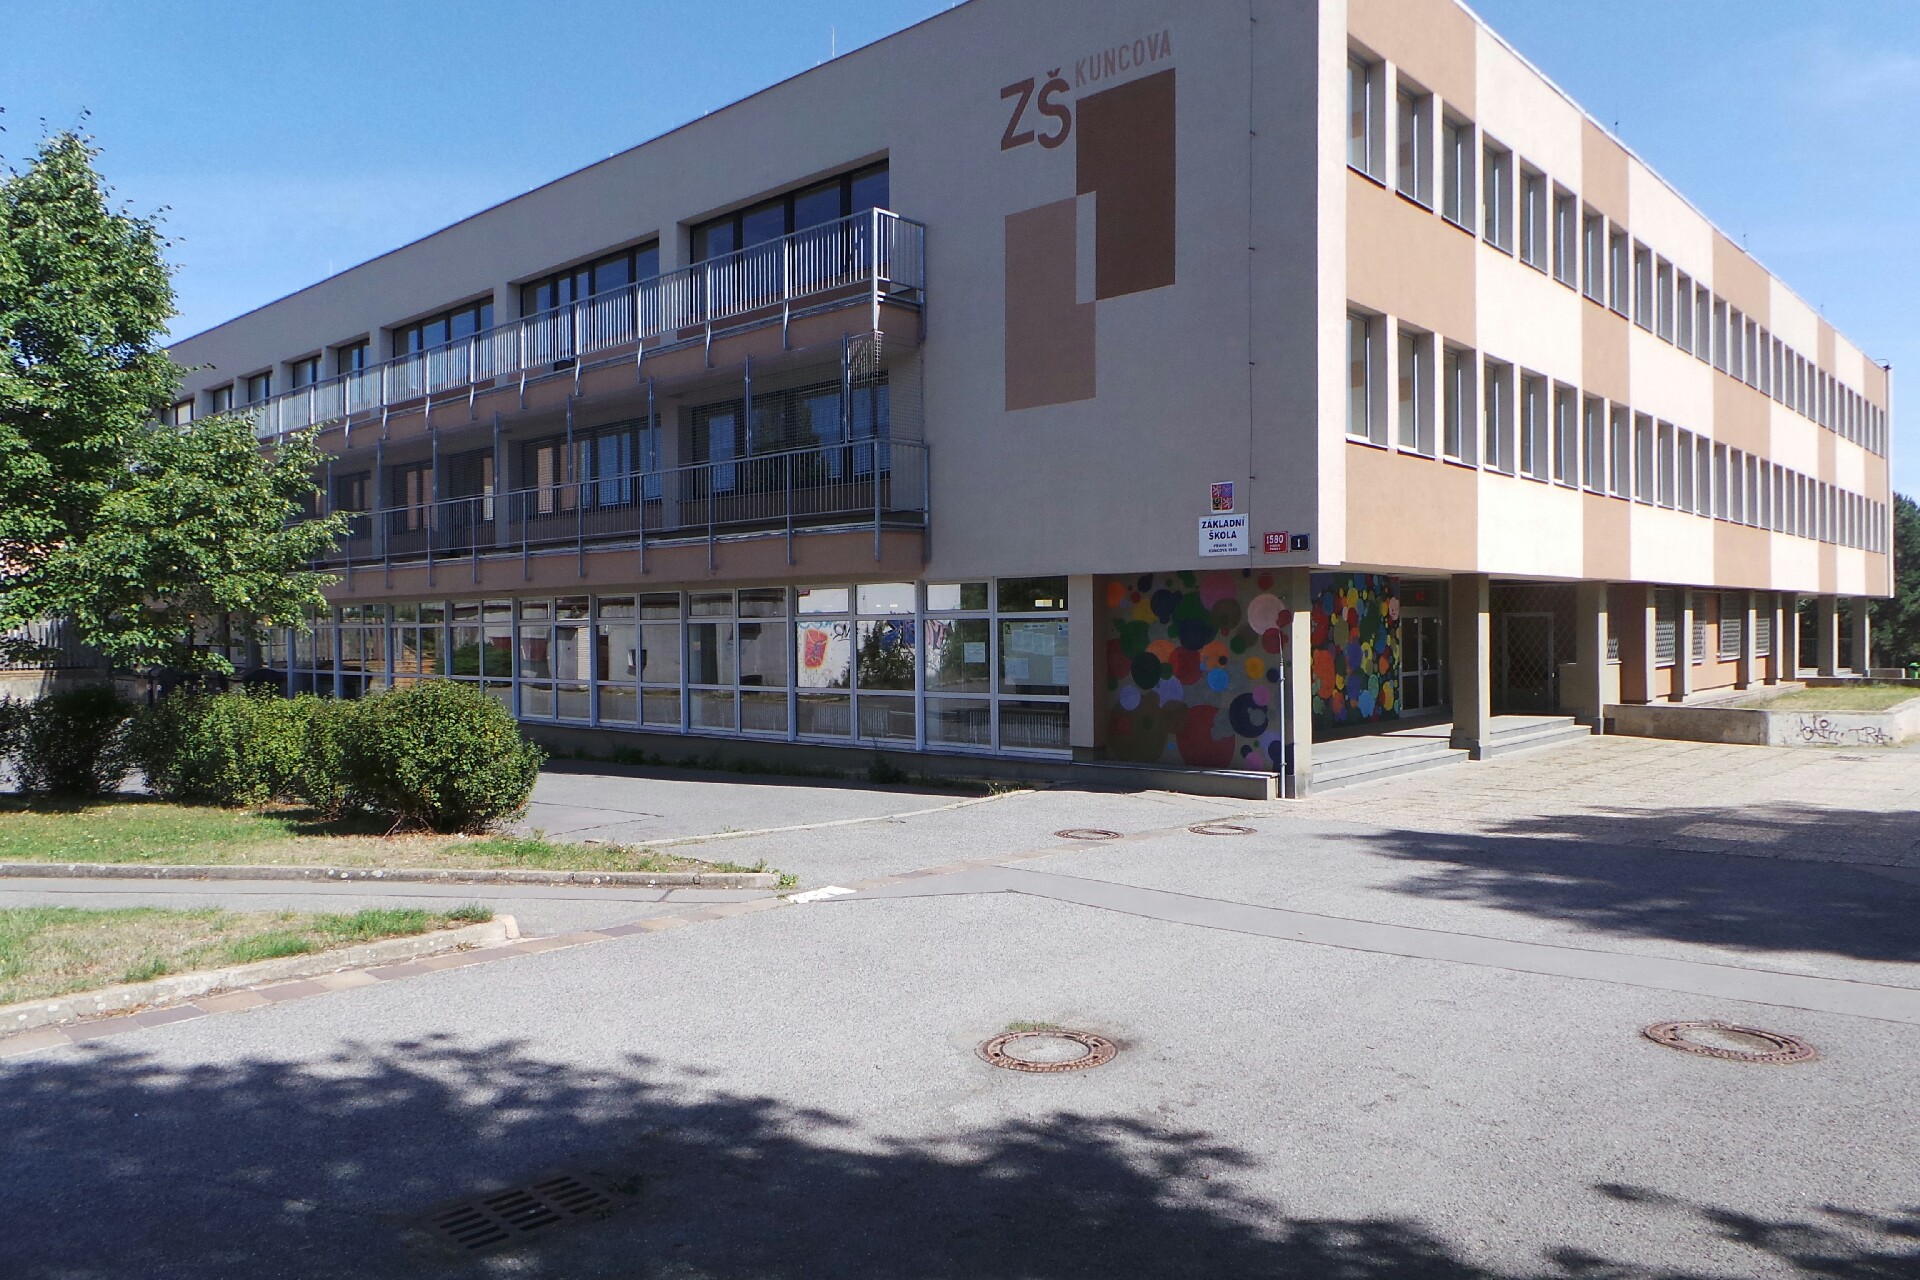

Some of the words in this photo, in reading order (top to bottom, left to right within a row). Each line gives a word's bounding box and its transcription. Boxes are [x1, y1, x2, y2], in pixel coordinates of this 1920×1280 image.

[1075, 29, 1172, 87] KUNCOVA
[1001, 67, 1072, 151] ZŠ
[1201, 516, 1245, 529] ZÁKLADNÍ
[1208, 529, 1237, 540] ŠKOLA
[1266, 534, 1284, 544] 1580
[1297, 538, 1301, 548] 1
